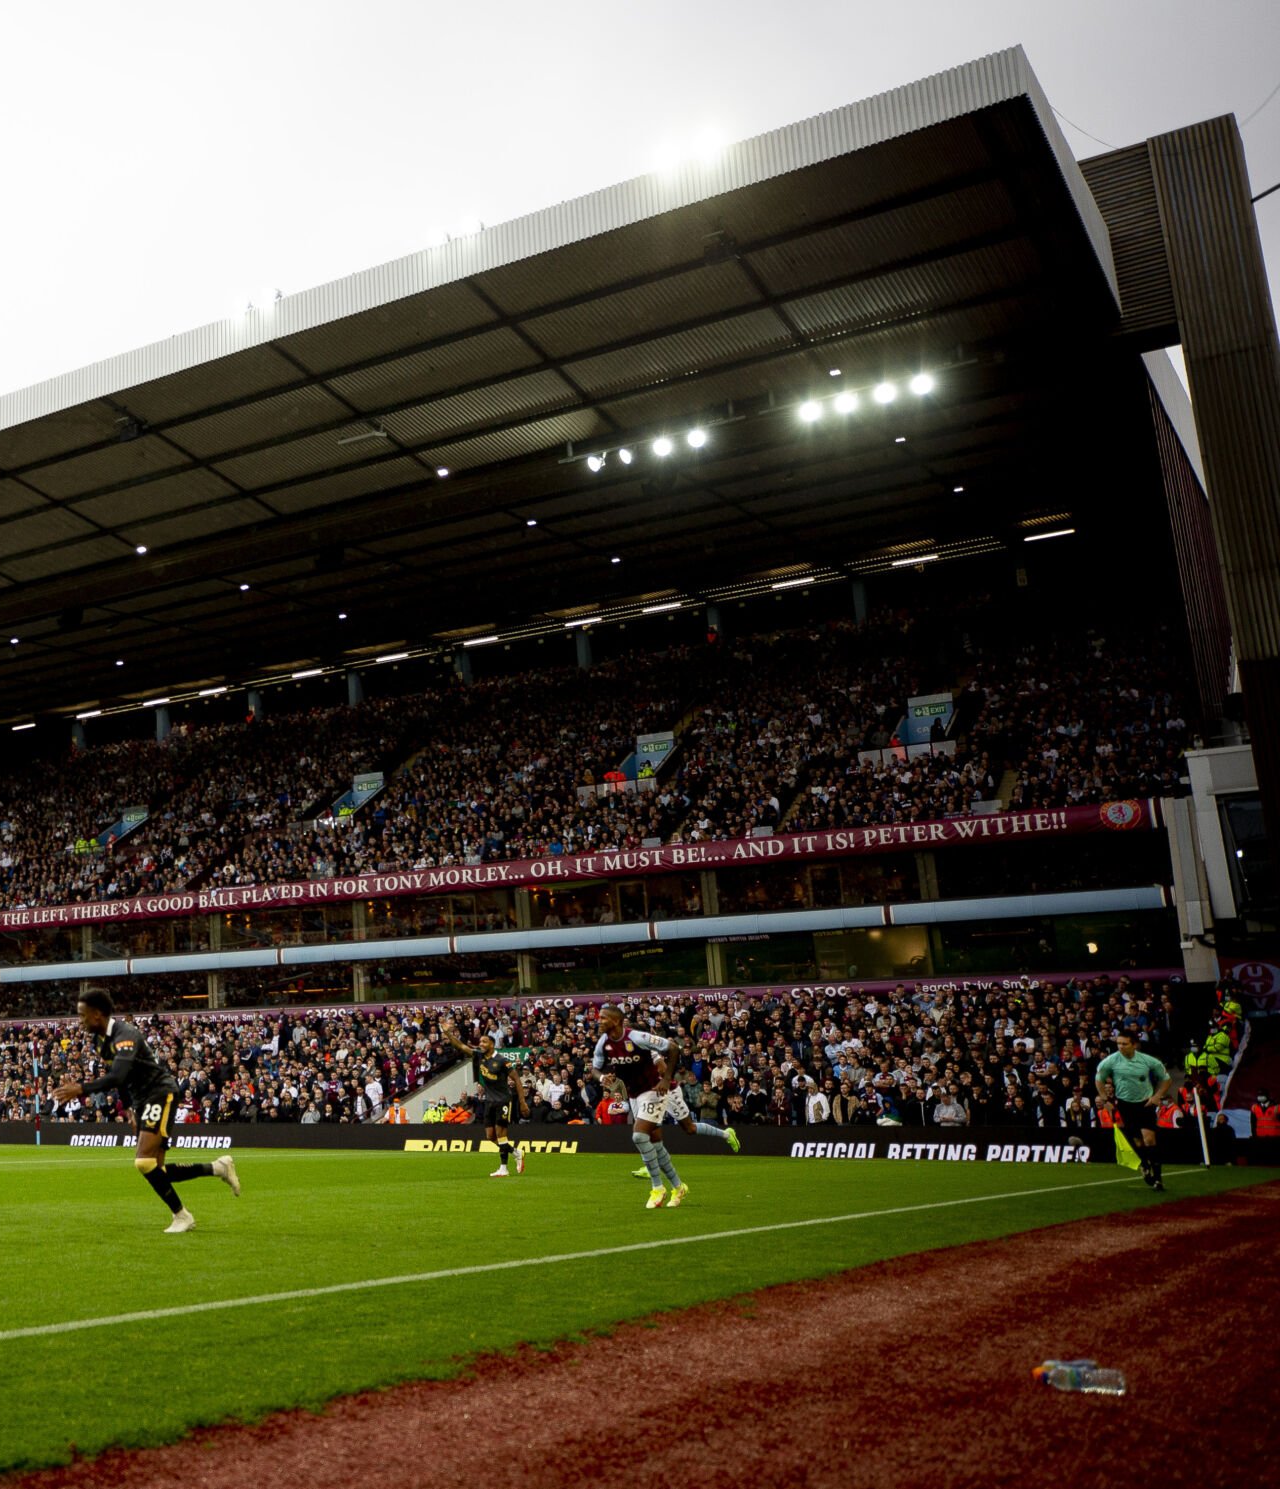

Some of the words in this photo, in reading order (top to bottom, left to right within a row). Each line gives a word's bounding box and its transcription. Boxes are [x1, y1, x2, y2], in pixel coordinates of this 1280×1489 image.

[3, 910, 30, 926] THE
[33, 907, 69, 924] LEFT,
[72, 902, 130, 920] THERE'S
[133, 903, 142, 913] A
[147, 897, 193, 912] GOOD
[199, 891, 238, 908] BALL
[242, 884, 304, 904] PLAYED
[309, 885, 328, 898] IN
[334, 880, 368, 895] FOR
[373, 874, 422, 892] TONY
[429, 865, 524, 888] MORLEY...
[530, 860, 569, 878] OH,
[575, 857, 596, 873] IT
[604, 850, 664, 871] MUST
[733, 839, 784, 859] AND
[792, 835, 817, 853] IT
[826, 831, 855, 850] IS!
[862, 823, 946, 847] PETER
[951, 812, 1068, 839] WITHE!!
[141, 1103, 162, 1121] 28
[502, 1105, 508, 1115] 9
[70, 1135, 118, 1147] OFFICIAL
[176, 1136, 232, 1148] PARTNER
[791, 1142, 876, 1158] OFFICIAL
[887, 1144, 977, 1160] BETTING
[986, 1144, 1091, 1163] PARTNER
